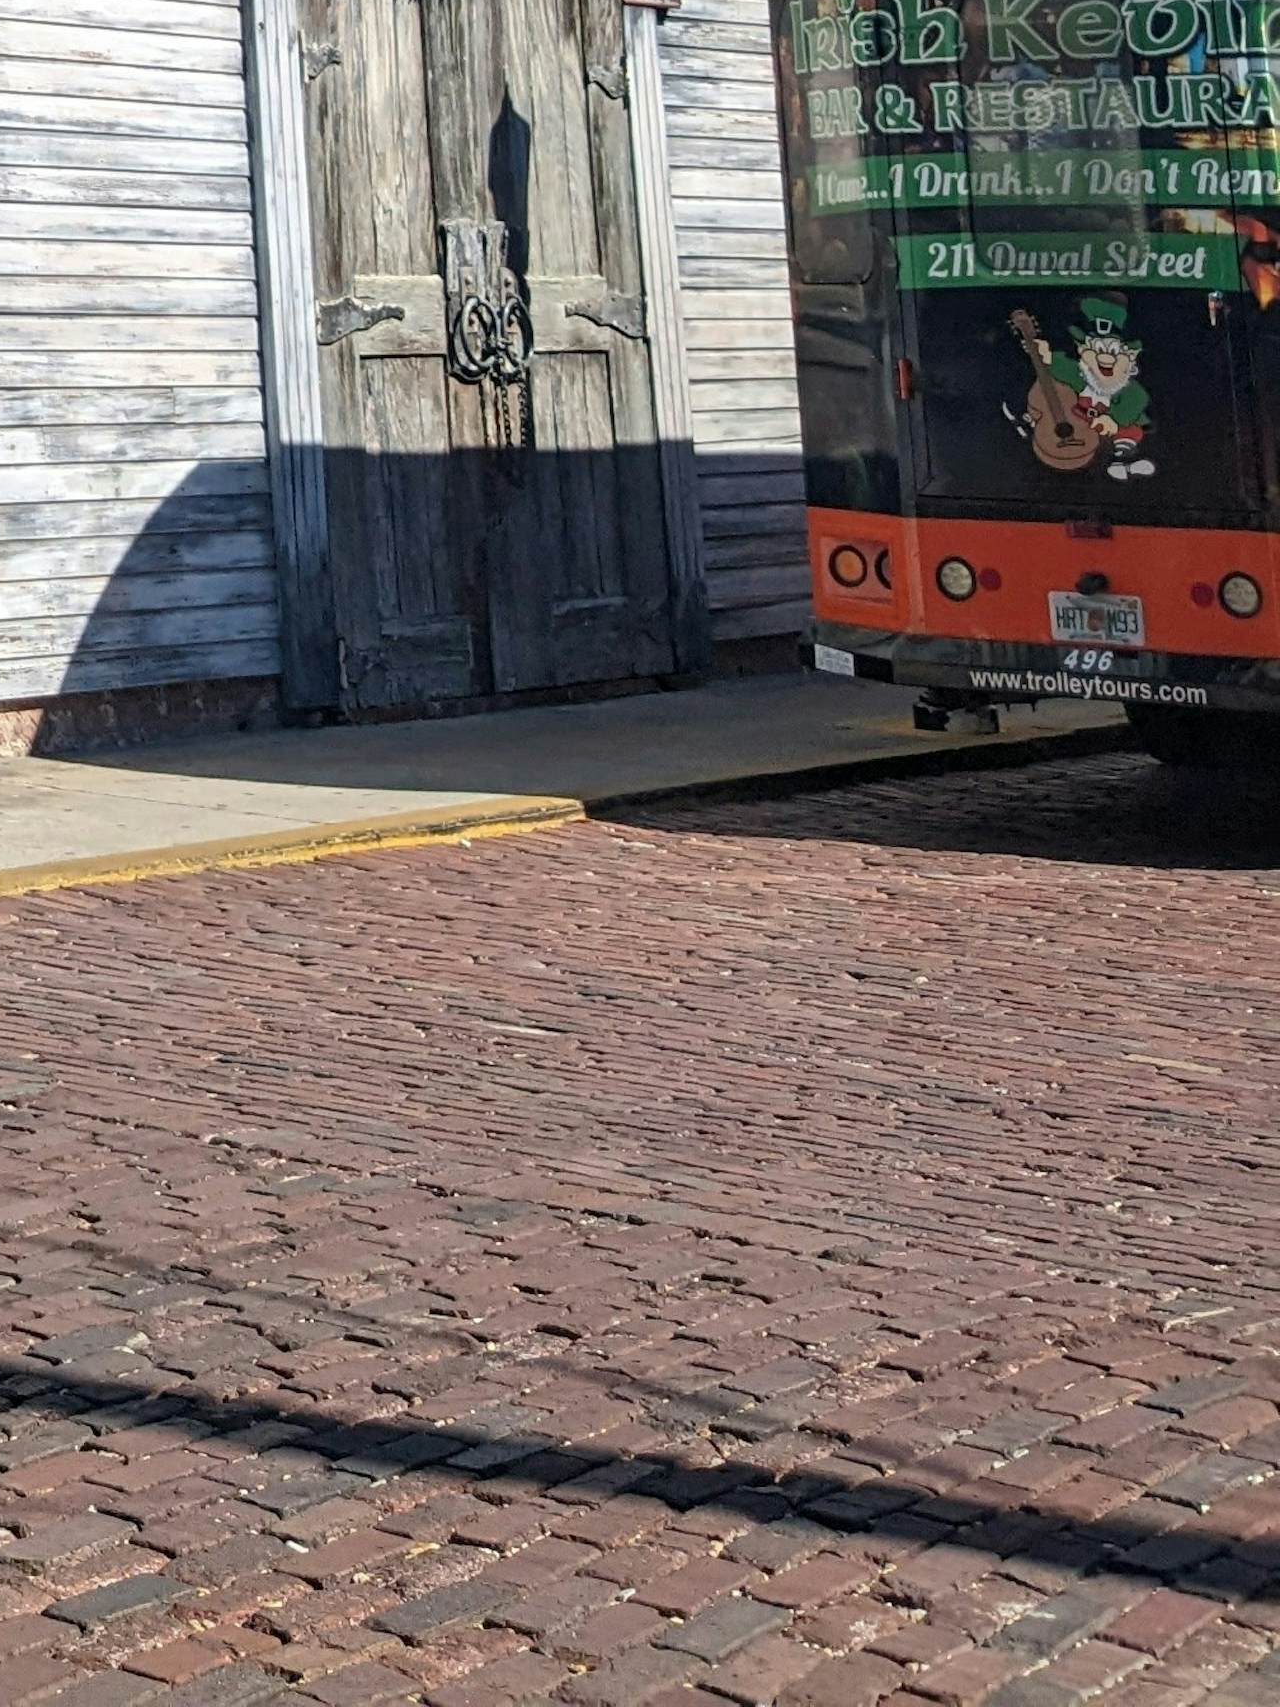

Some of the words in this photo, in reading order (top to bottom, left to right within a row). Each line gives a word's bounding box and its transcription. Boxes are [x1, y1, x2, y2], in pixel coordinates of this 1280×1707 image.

[807, 86, 870, 138] BAR
[874, 83, 924, 134] &
[928, 72, 1280, 133] RESTAURA
[1083, 158, 1181, 196] Don't
[927, 242, 977, 279] 211
[987, 240, 1092, 278] Duval
[1103, 240, 1207, 280] Street
[1063, 648, 1115, 671] 496
[969, 669, 1208, 706] www.trolleytours.com
